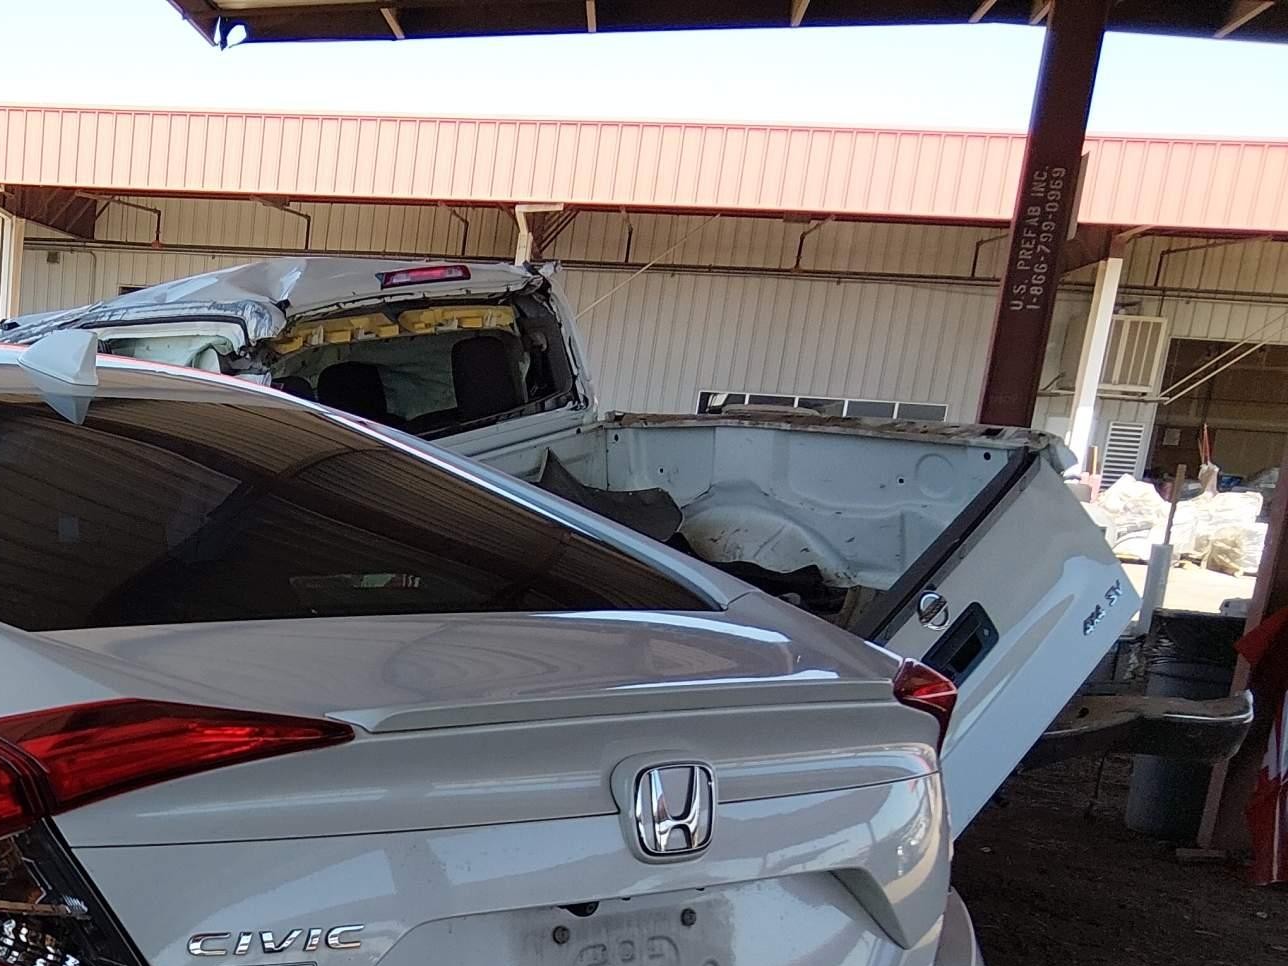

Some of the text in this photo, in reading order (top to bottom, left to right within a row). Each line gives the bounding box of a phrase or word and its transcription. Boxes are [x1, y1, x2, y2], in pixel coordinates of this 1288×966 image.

[1010, 166, 1049, 311] U.S. PREFAB INC.
[1026, 167, 1067, 310] 1-866-799-0969
[186, 924, 365, 957] CIVIC
